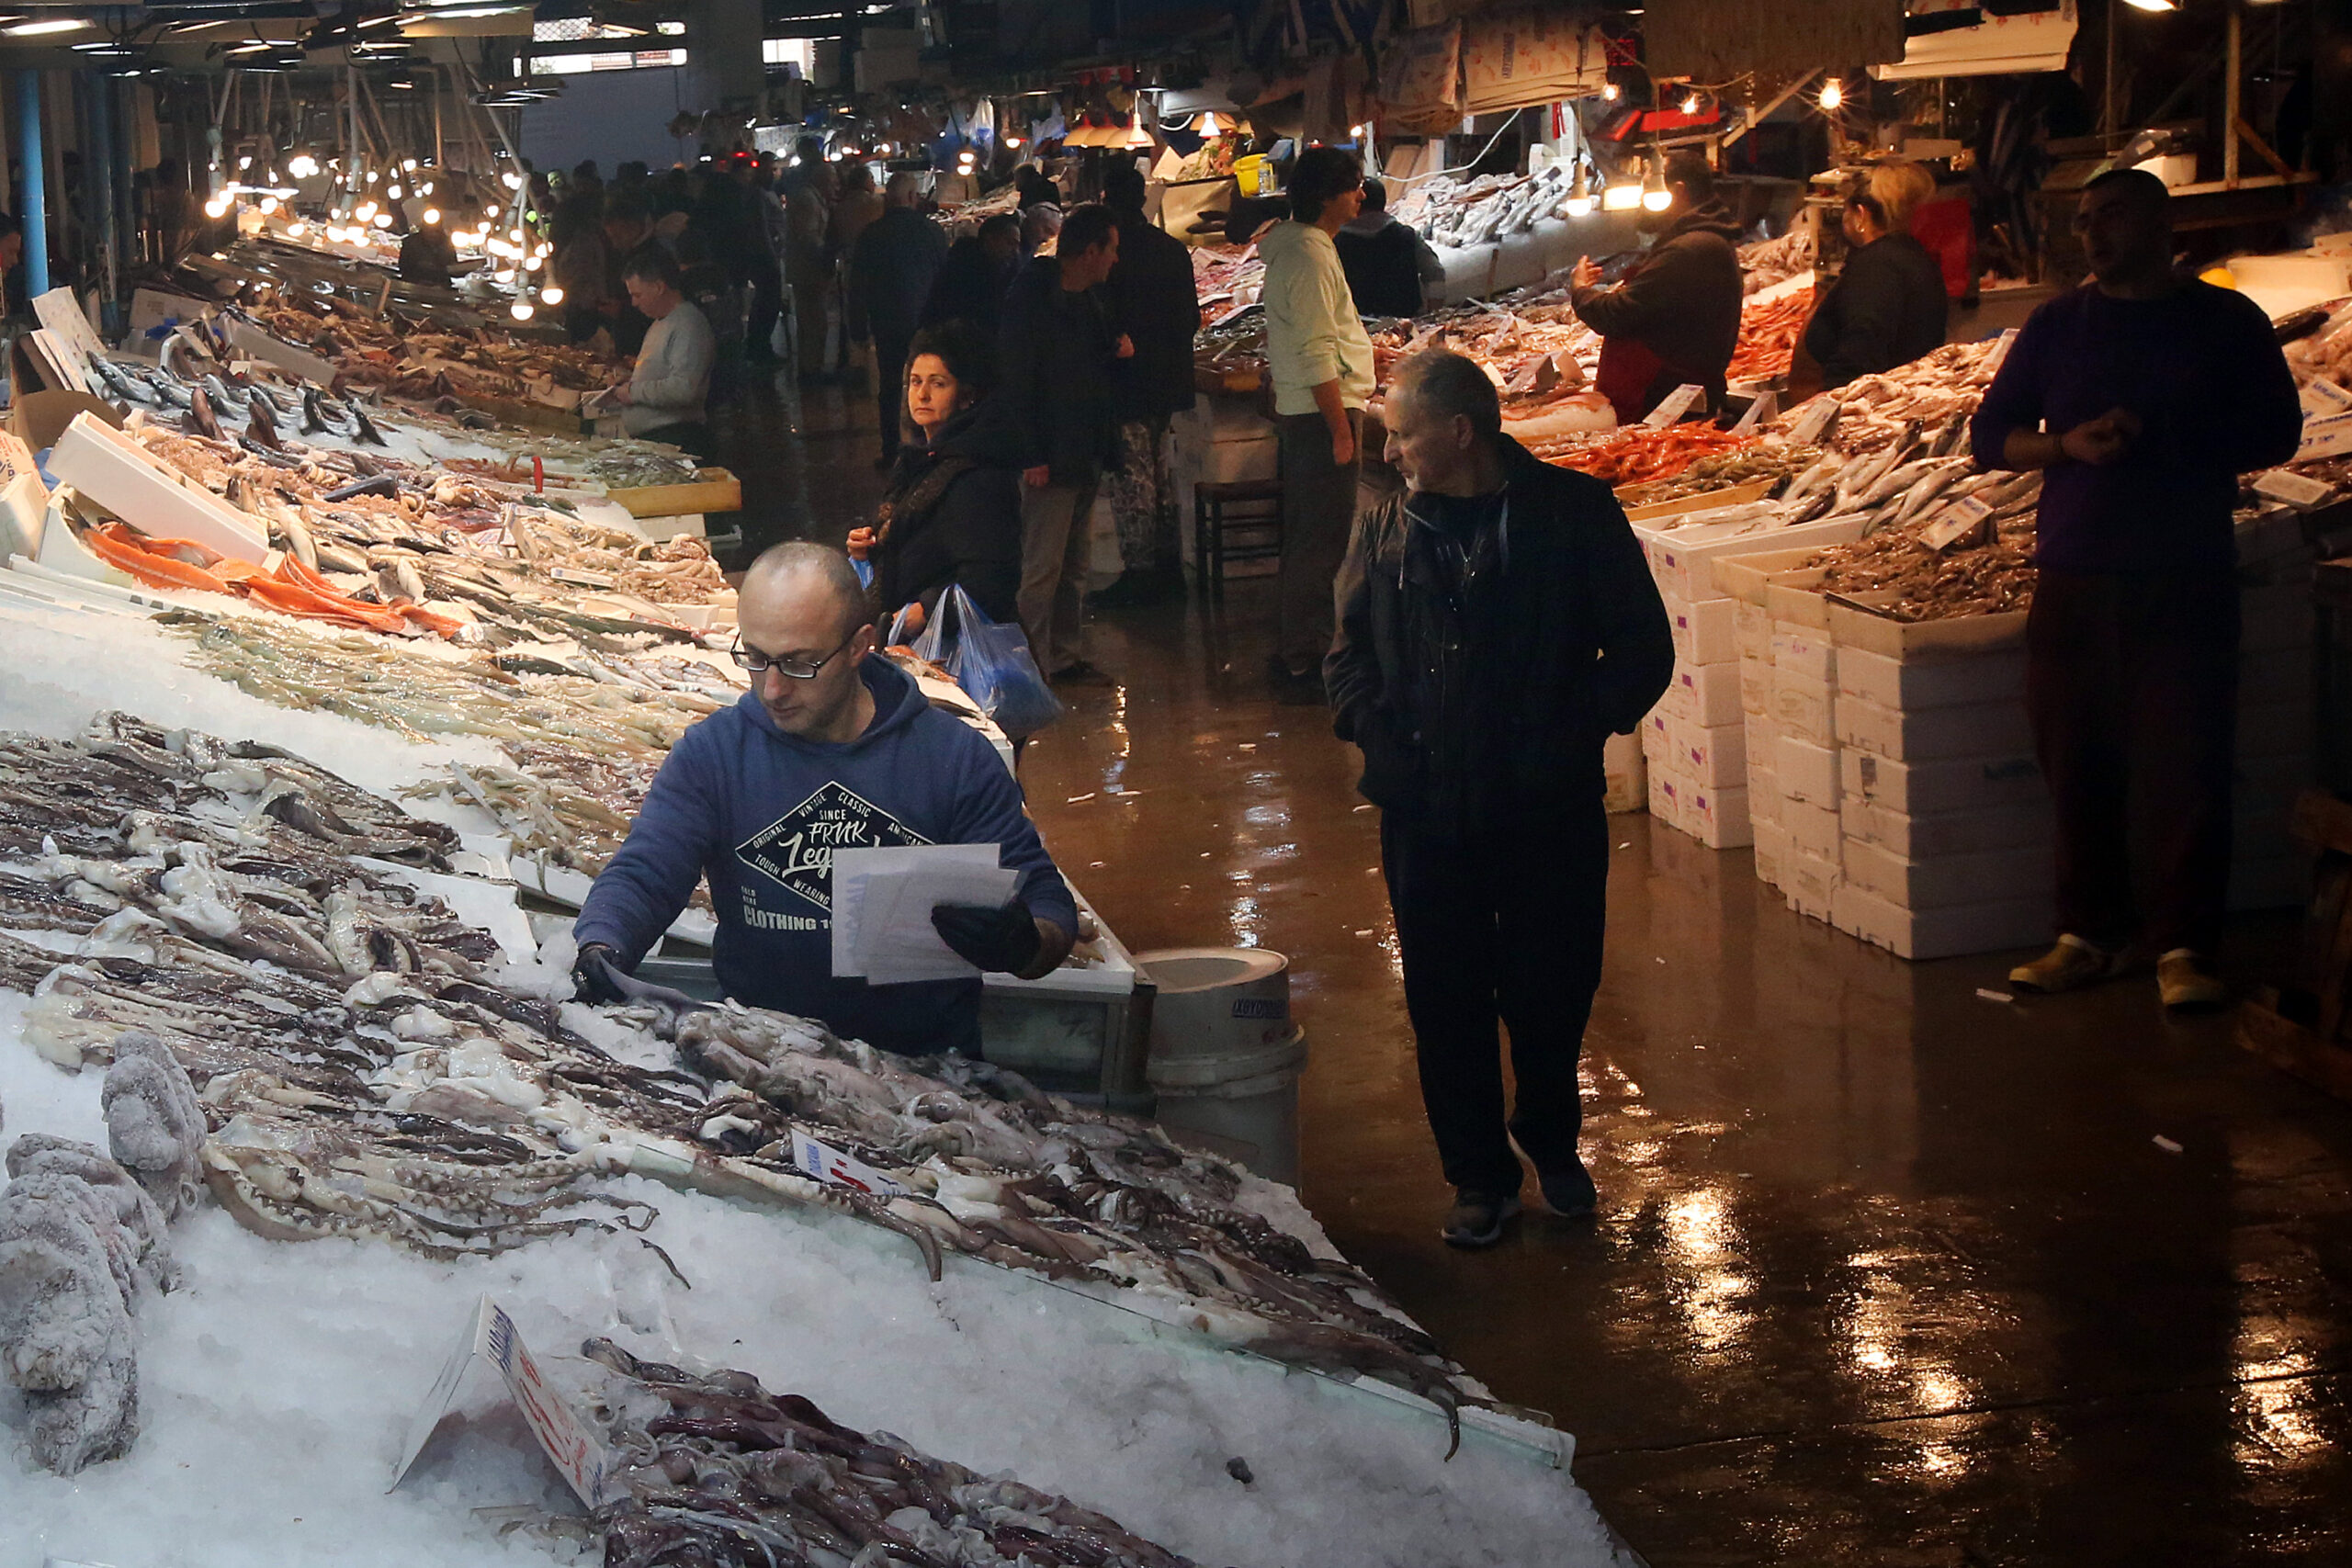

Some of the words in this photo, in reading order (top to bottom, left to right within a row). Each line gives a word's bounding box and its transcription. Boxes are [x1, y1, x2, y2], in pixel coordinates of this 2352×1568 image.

[819, 808, 847, 821] SINCE
[838, 792, 872, 818] CLASSIC
[752, 823, 787, 849] ORIGINAL
[754, 853, 781, 876] TOUGH
[793, 878, 831, 907] WEARING
[744, 905, 818, 931] CLOTHING
